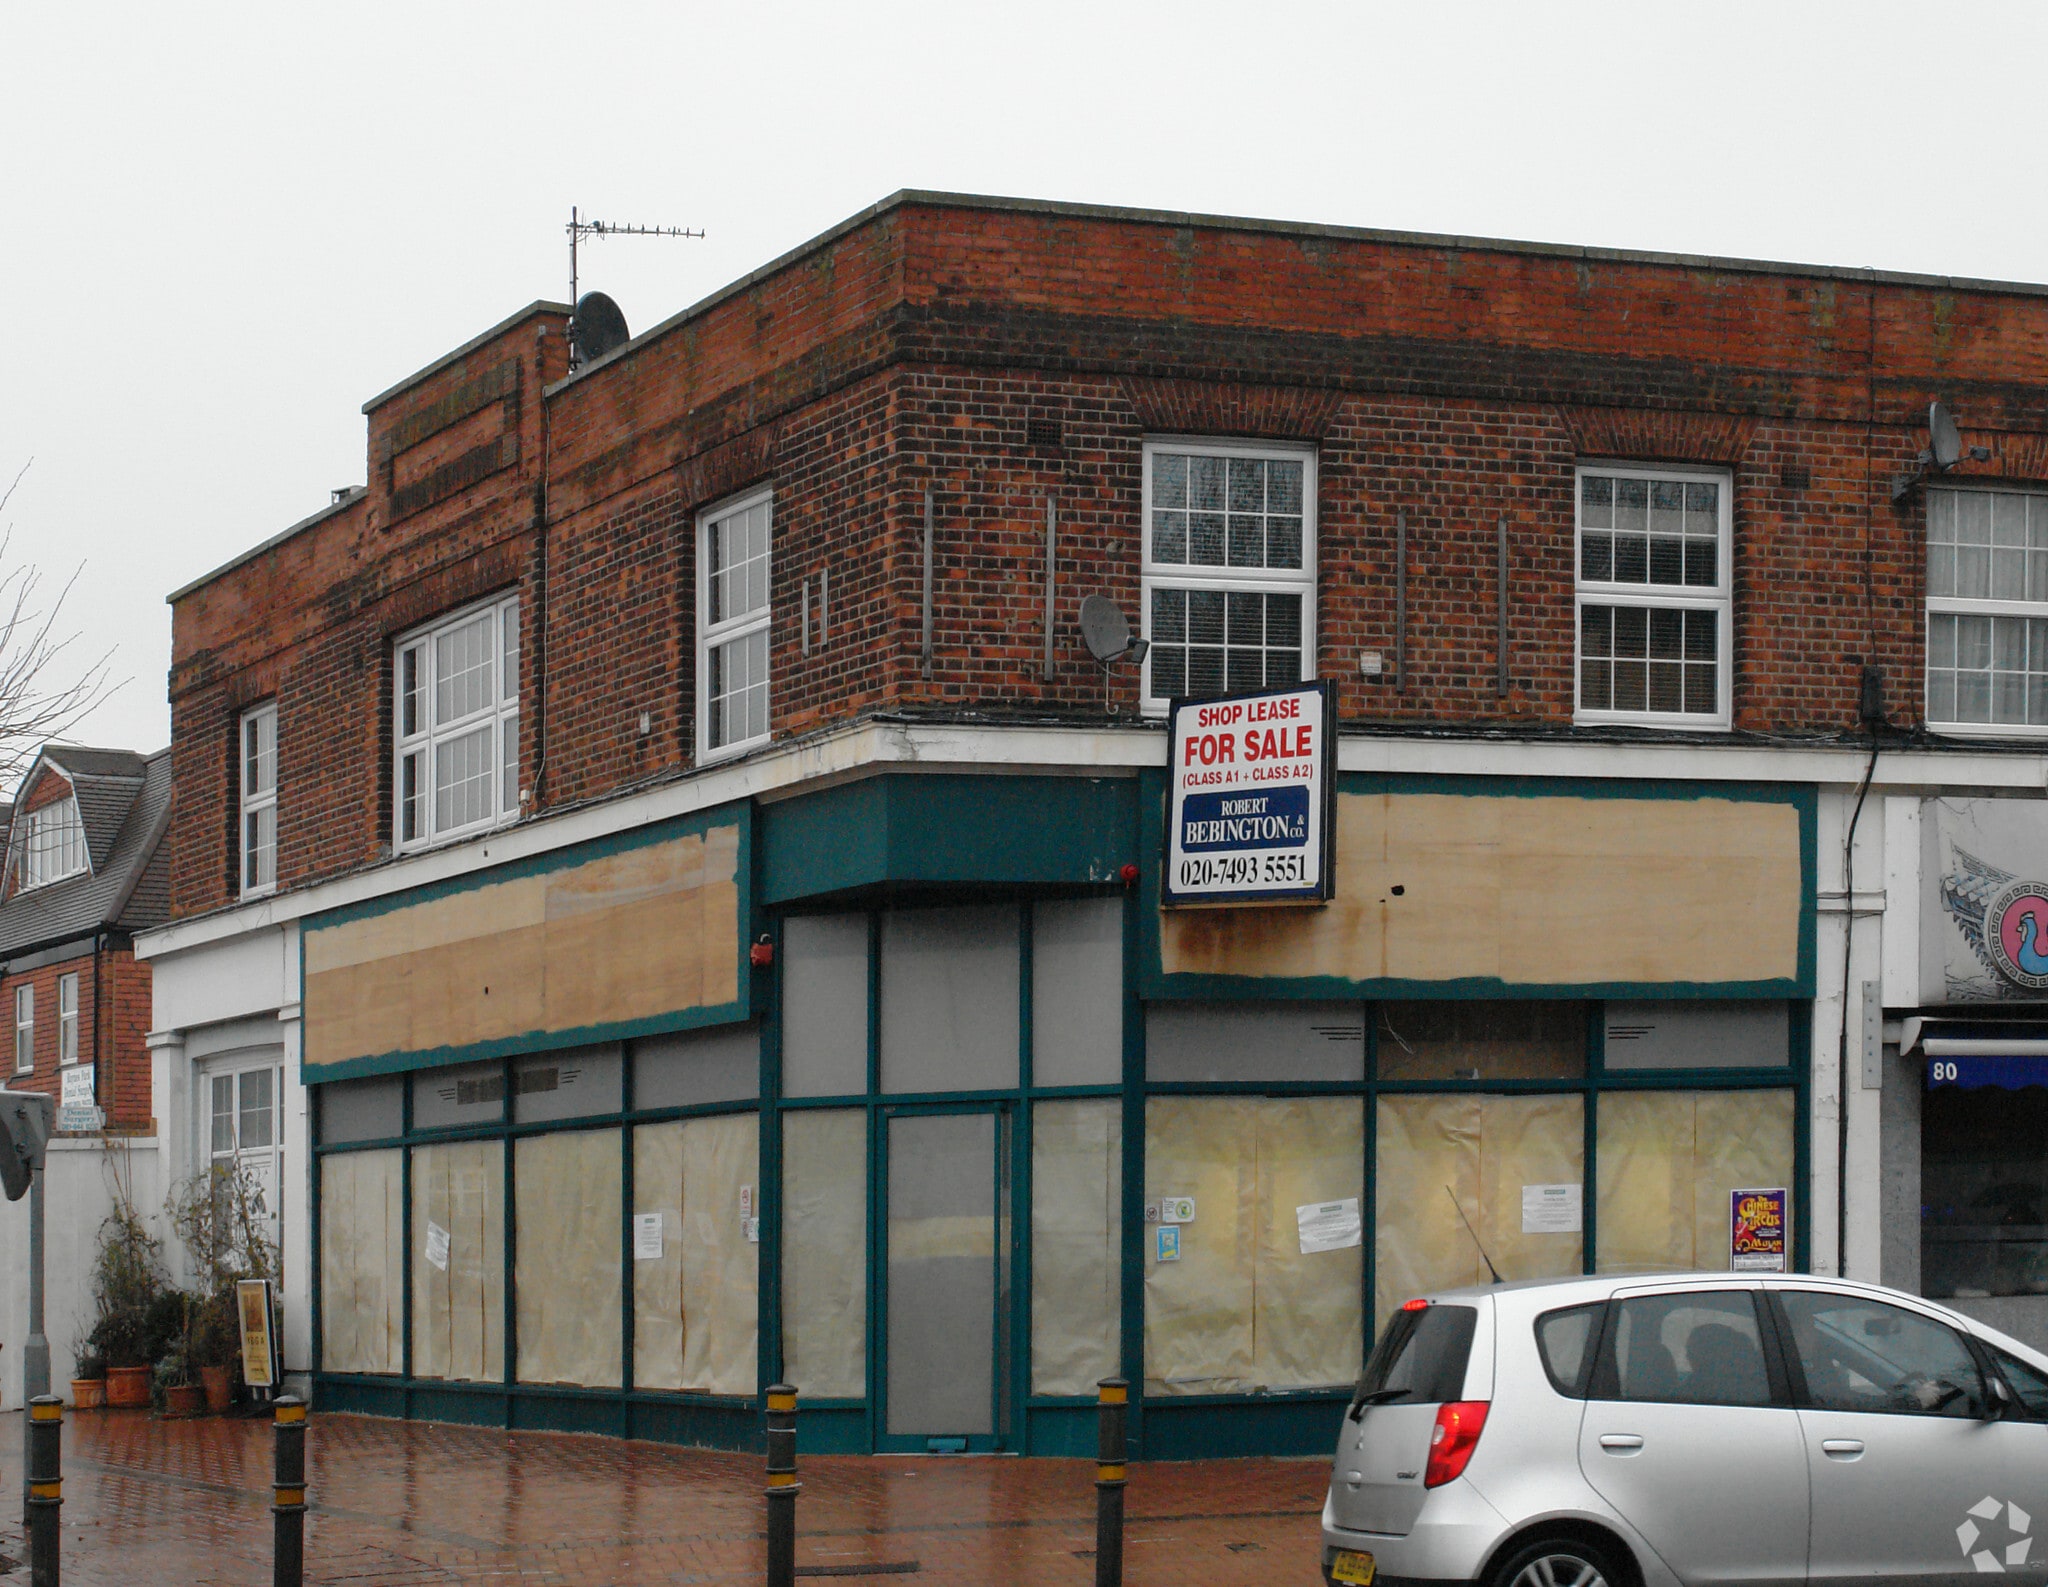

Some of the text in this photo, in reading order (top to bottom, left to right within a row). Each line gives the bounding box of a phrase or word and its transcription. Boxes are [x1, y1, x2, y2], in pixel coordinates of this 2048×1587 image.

[1198, 698, 1300, 728] SHOP LEASE
[1184, 725, 1312, 767] FOR SALE
[1182, 770, 1222, 789] (CLASS
[1225, 769, 1239, 784] A1
[1252, 765, 1289, 781] CLASS
[1292, 763, 1313, 779] A2)
[1220, 797, 1269, 817] ROBERT
[1185, 815, 1290, 844] BEBINGTON
[1180, 854, 1306, 887] 020-7493 5551
[1933, 1062, 1957, 1081] 80
[1739, 1198, 1779, 1217] CHINESE
[1744, 1214, 1780, 1231] CIRCUS
